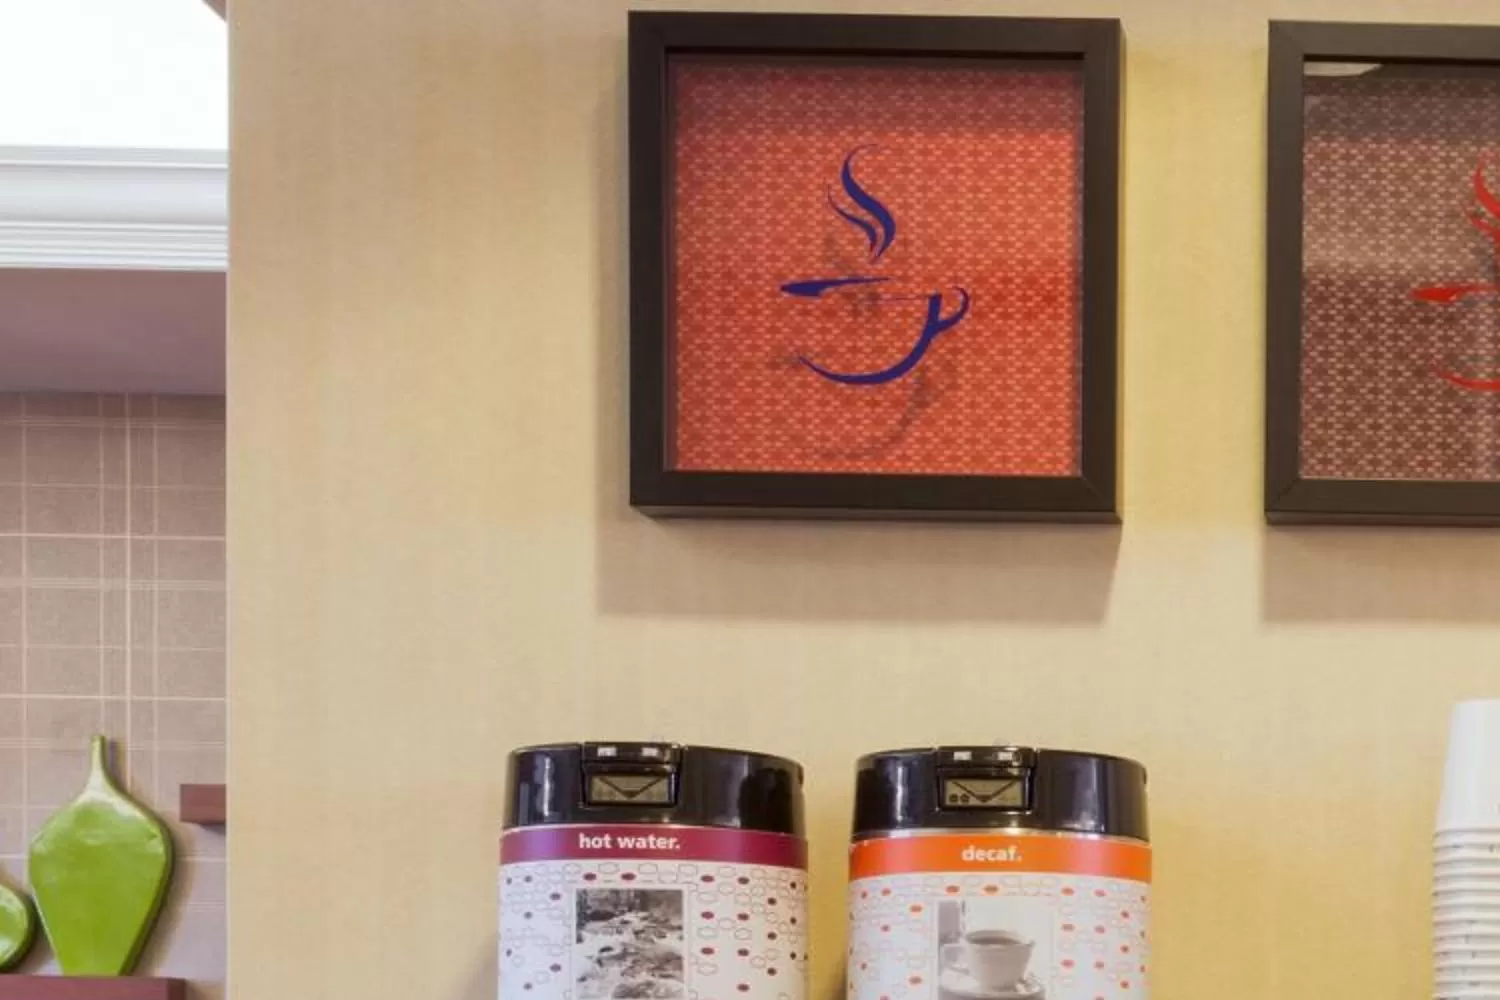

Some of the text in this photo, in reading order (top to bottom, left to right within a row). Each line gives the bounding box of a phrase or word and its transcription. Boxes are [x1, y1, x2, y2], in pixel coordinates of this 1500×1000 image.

[579, 832, 681, 850] hot water.
[960, 844, 1023, 862] decaf.
